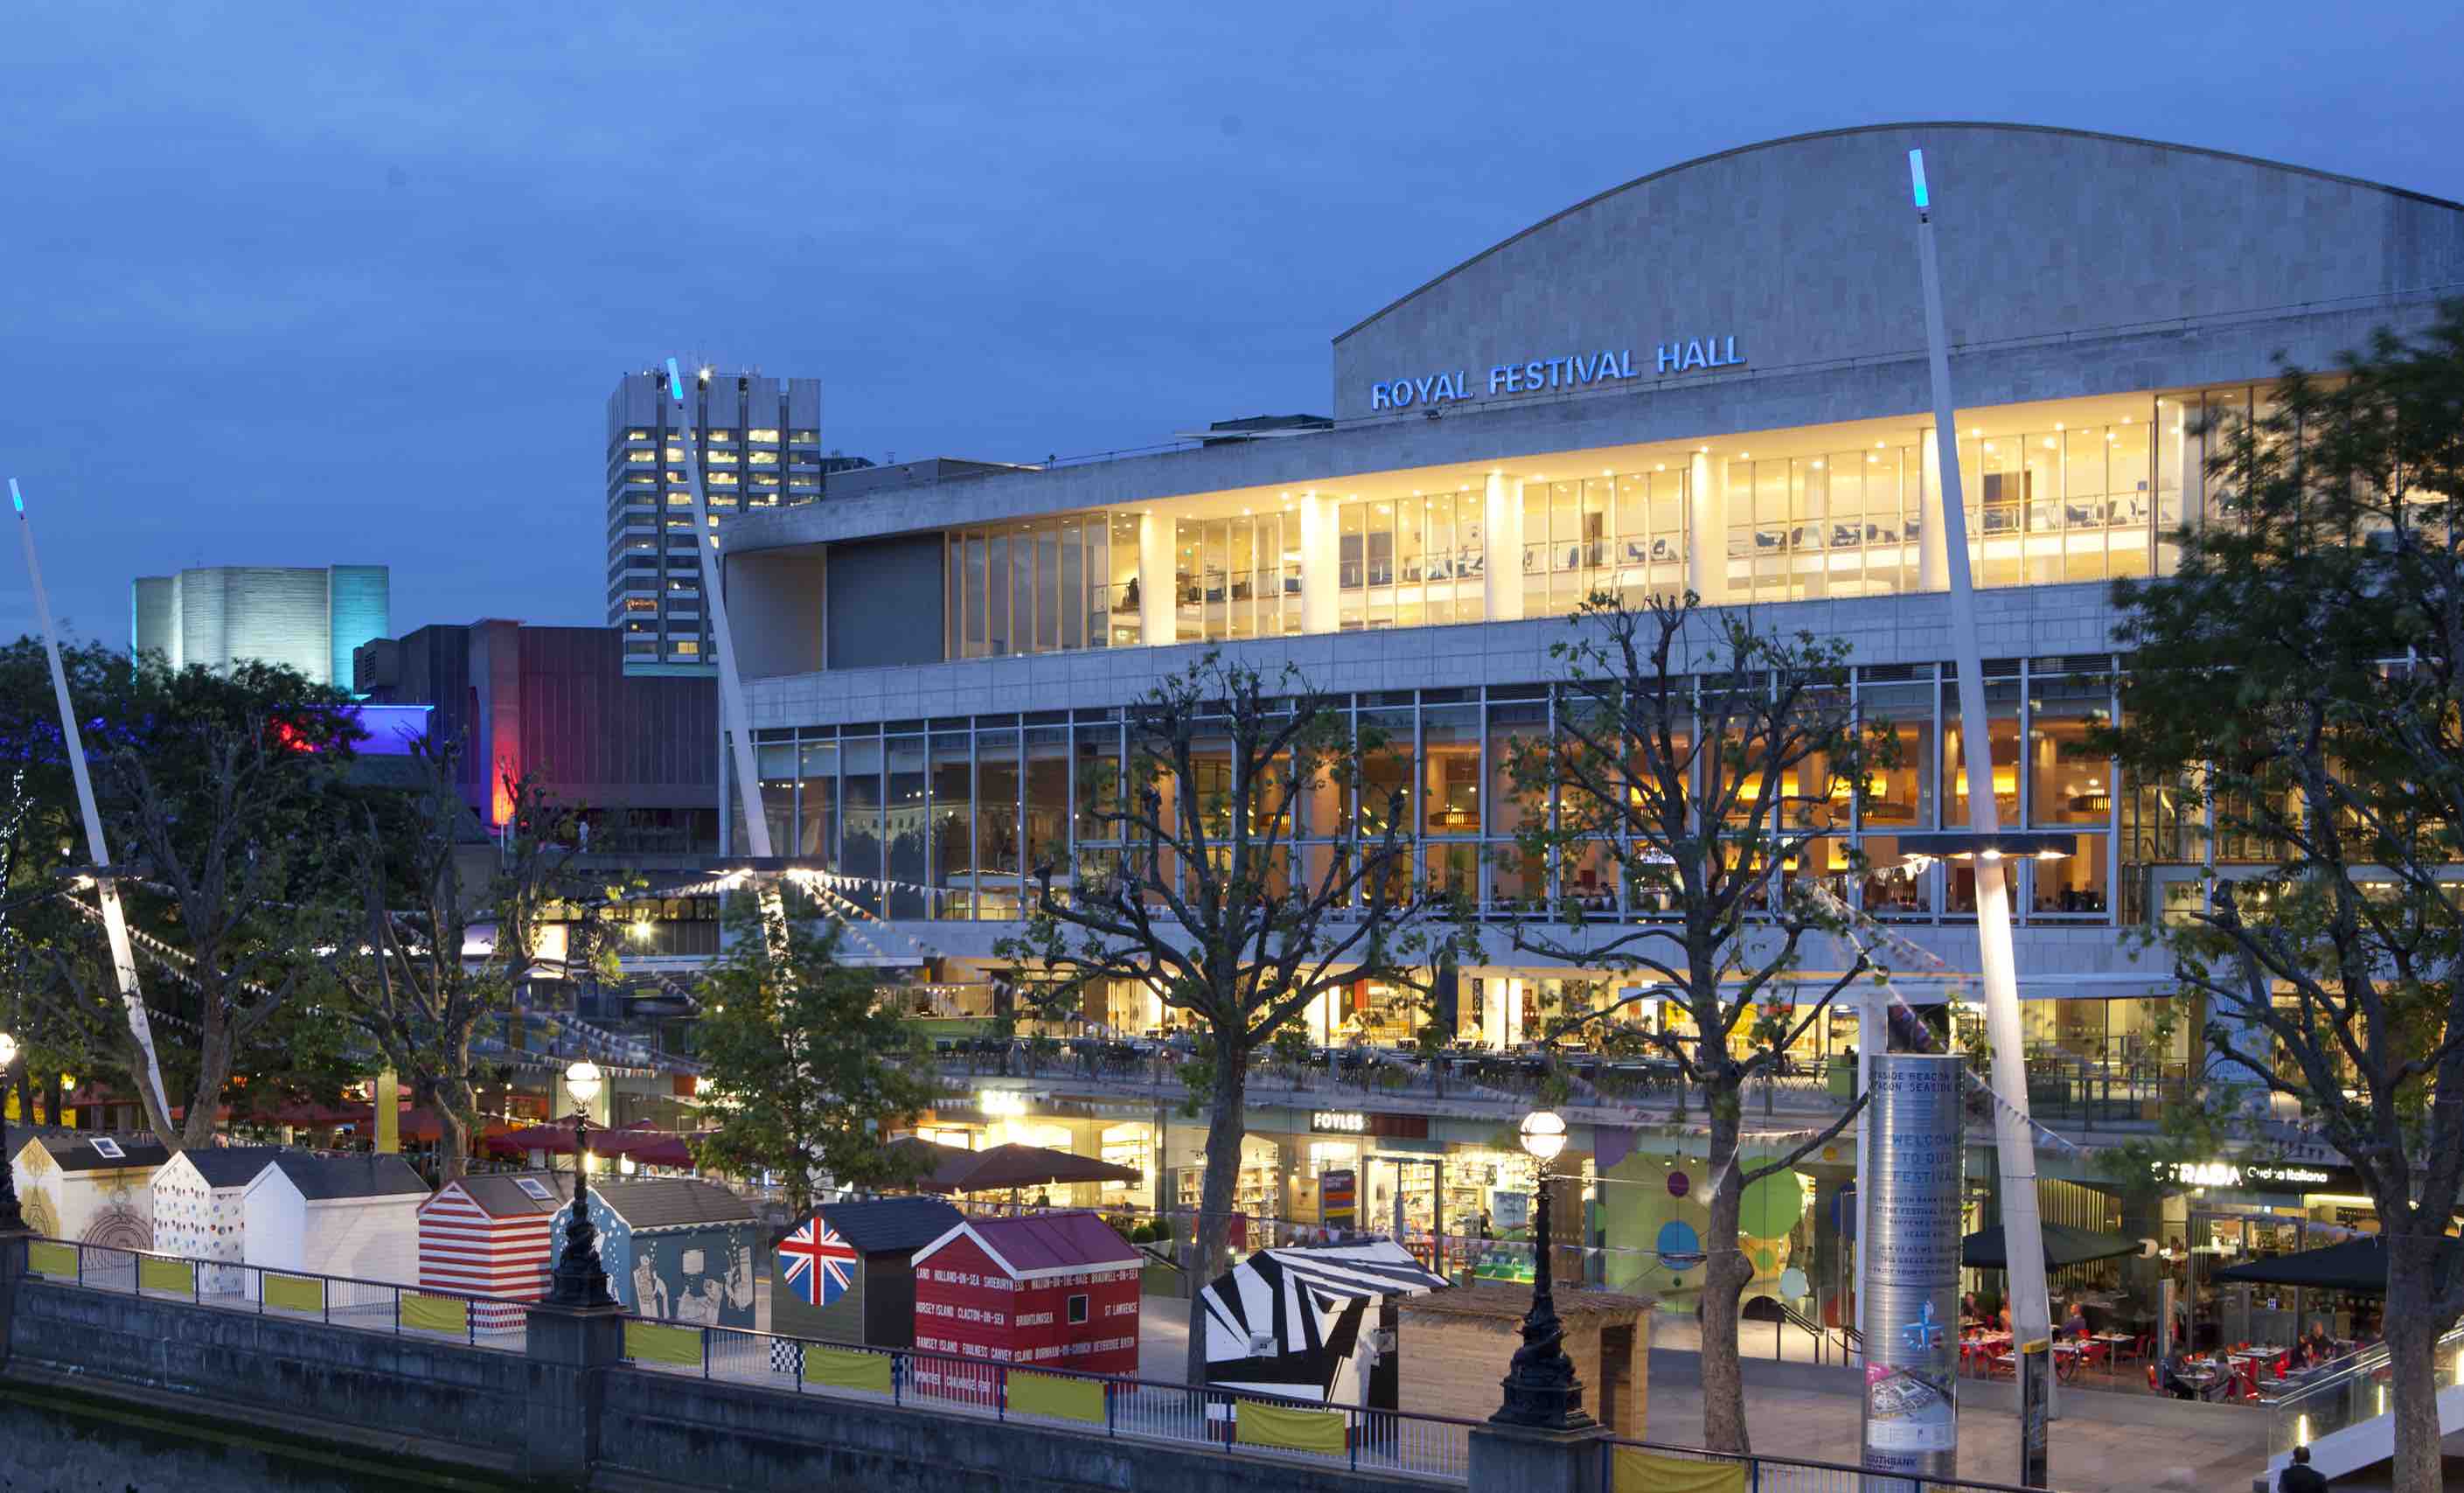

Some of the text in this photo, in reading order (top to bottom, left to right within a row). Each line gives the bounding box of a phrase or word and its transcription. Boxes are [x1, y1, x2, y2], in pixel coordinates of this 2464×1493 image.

[1371, 335, 1747, 411] ROYAL FESTIVAL HALL
[1314, 1112, 1364, 1131] FOYLES
[1902, 1153, 1918, 1163] TO
[2287, 1169, 2328, 1183] Italiana
[934, 1269, 979, 1286] HOLLAND-ON-SEA
[936, 1304, 954, 1317] ISLAND
[957, 1307, 1005, 1325] CLACTON-ON-SEA
[938, 1338, 957, 1353] ISLAND
[963, 1343, 989, 1357] FOULNESS
[991, 1347, 1013, 1361] CANVEY
[1014, 1348, 1034, 1362] ISLAND
